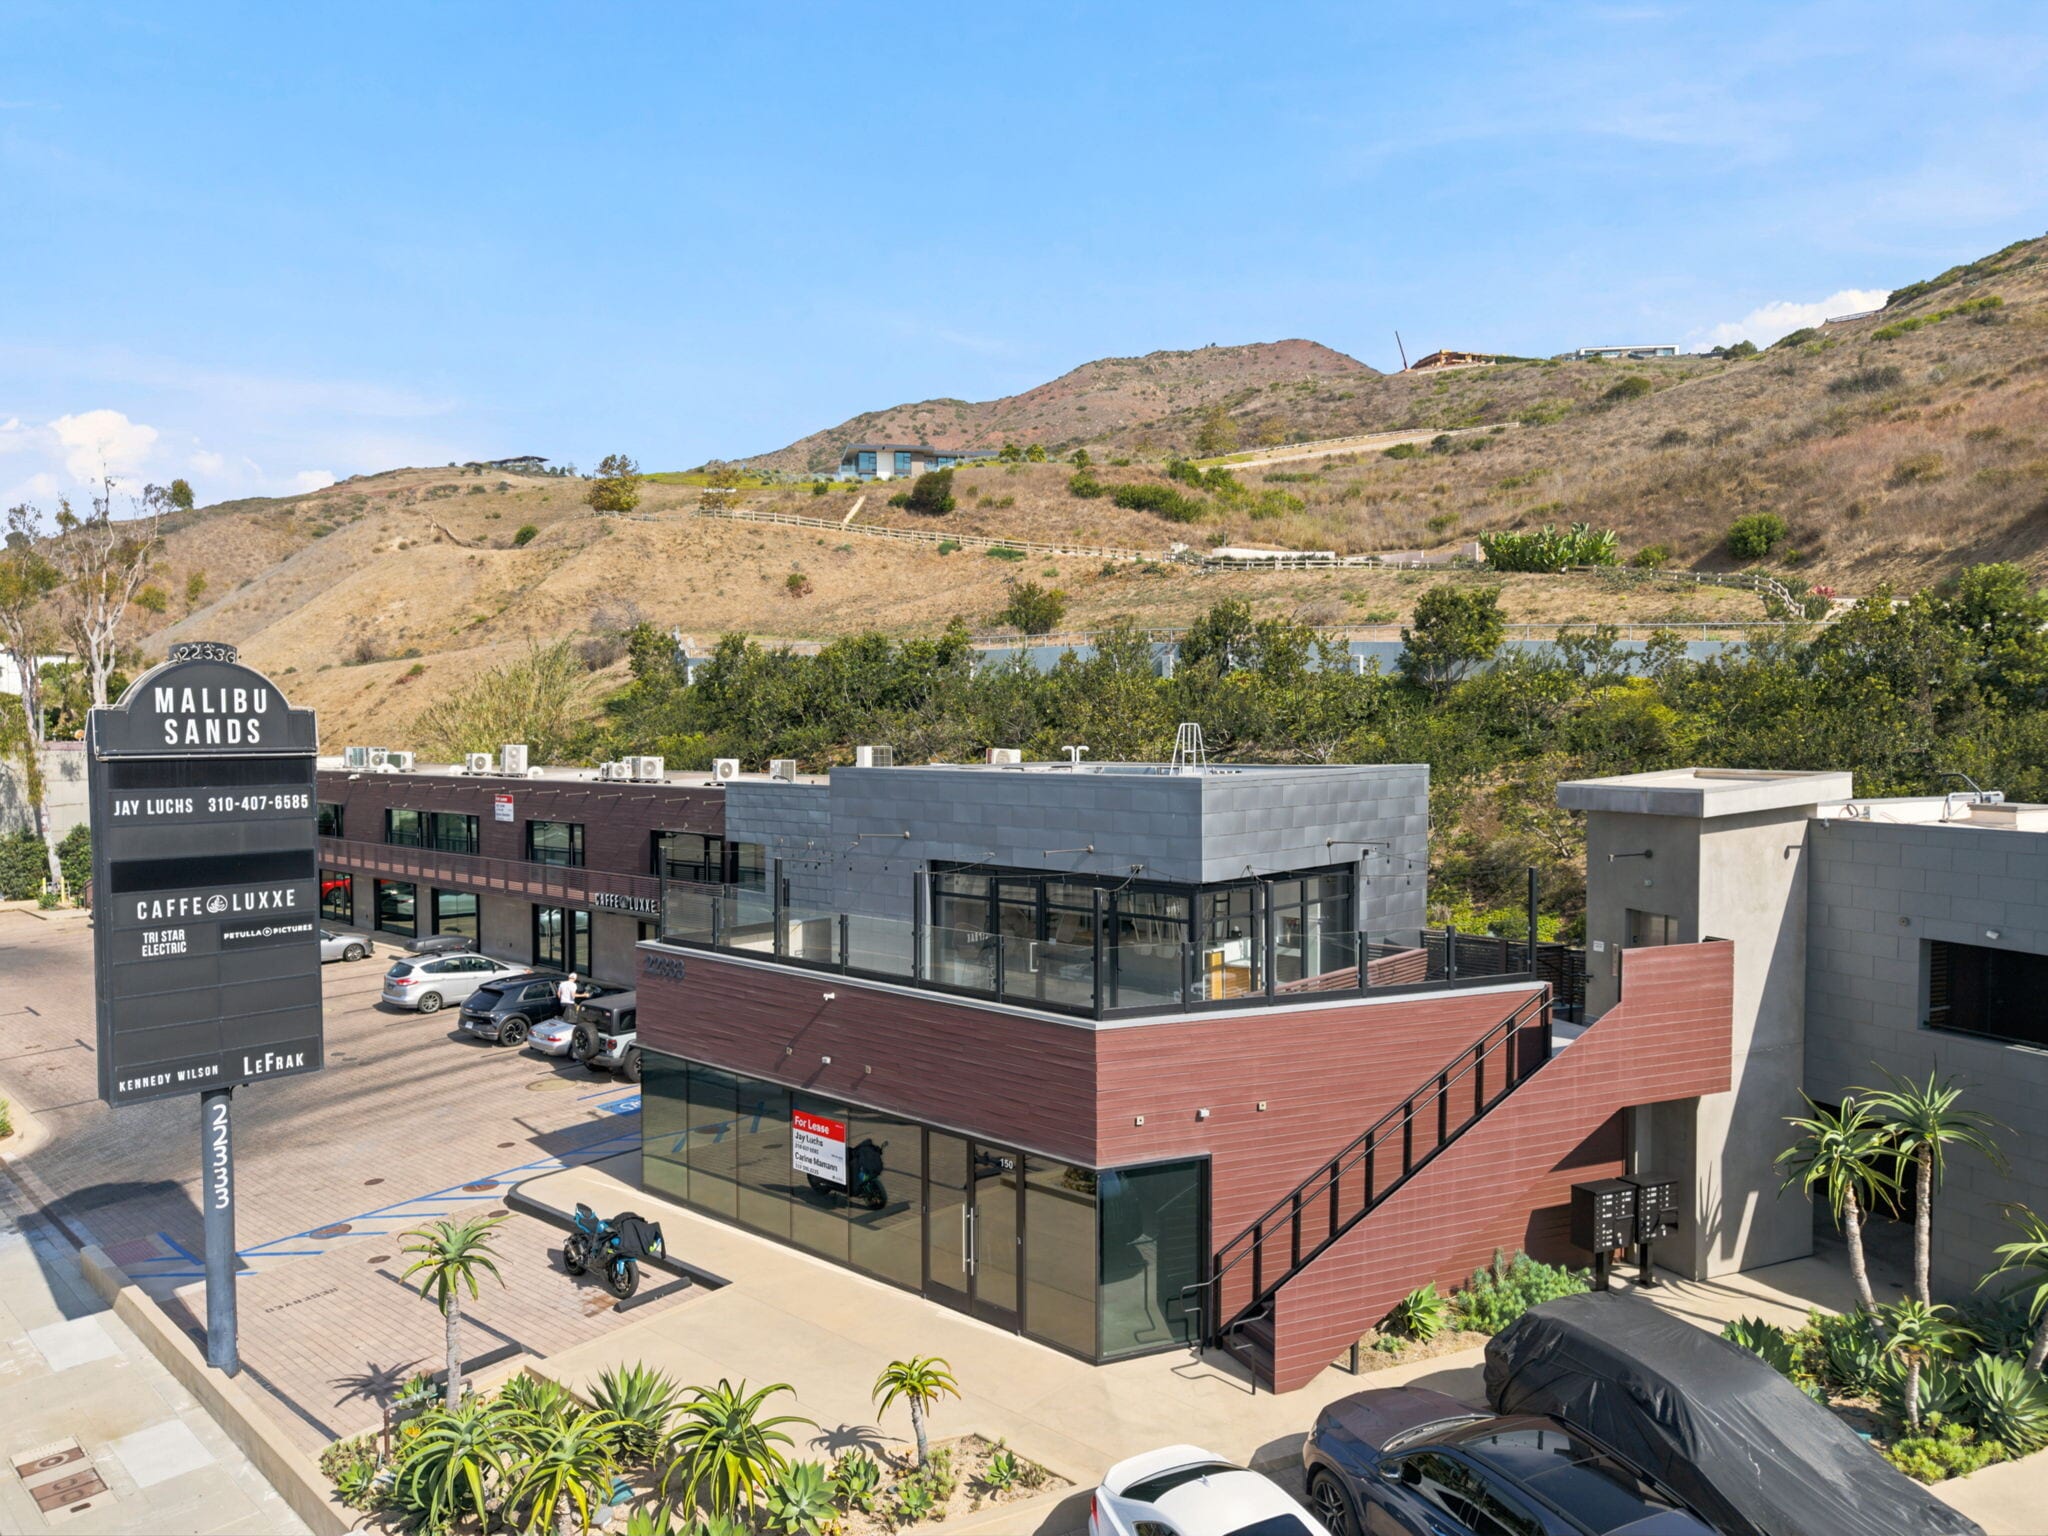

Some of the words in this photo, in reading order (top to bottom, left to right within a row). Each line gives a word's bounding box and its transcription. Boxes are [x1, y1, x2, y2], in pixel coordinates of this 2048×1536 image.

[155, 687, 267, 713] MALIBU
[164, 718, 260, 744] SANDS
[114, 800, 140, 816] JAY
[147, 798, 193, 815] LUCHS
[208, 794, 309, 812] 310-407-6585
[137, 897, 202, 920] CAFFE
[232, 889, 296, 911] LUXXE
[594, 892, 618, 908] CAFFE
[629, 896, 657, 913] LUXXE
[143, 931, 158, 944] TRI
[161, 929, 185, 942] STAR
[223, 930, 262, 940] PETULLA
[273, 924, 313, 935] PICTURES
[141, 941, 187, 957] ELECTRIC
[119, 1073, 171, 1092] KENNEDY
[177, 1065, 219, 1082] WILSON
[794, 1115, 807, 1128] For
[808, 1119, 830, 1135] Lease
[212, 1103, 229, 1209] 22333
[1000, 1157, 1014, 1169] 150
